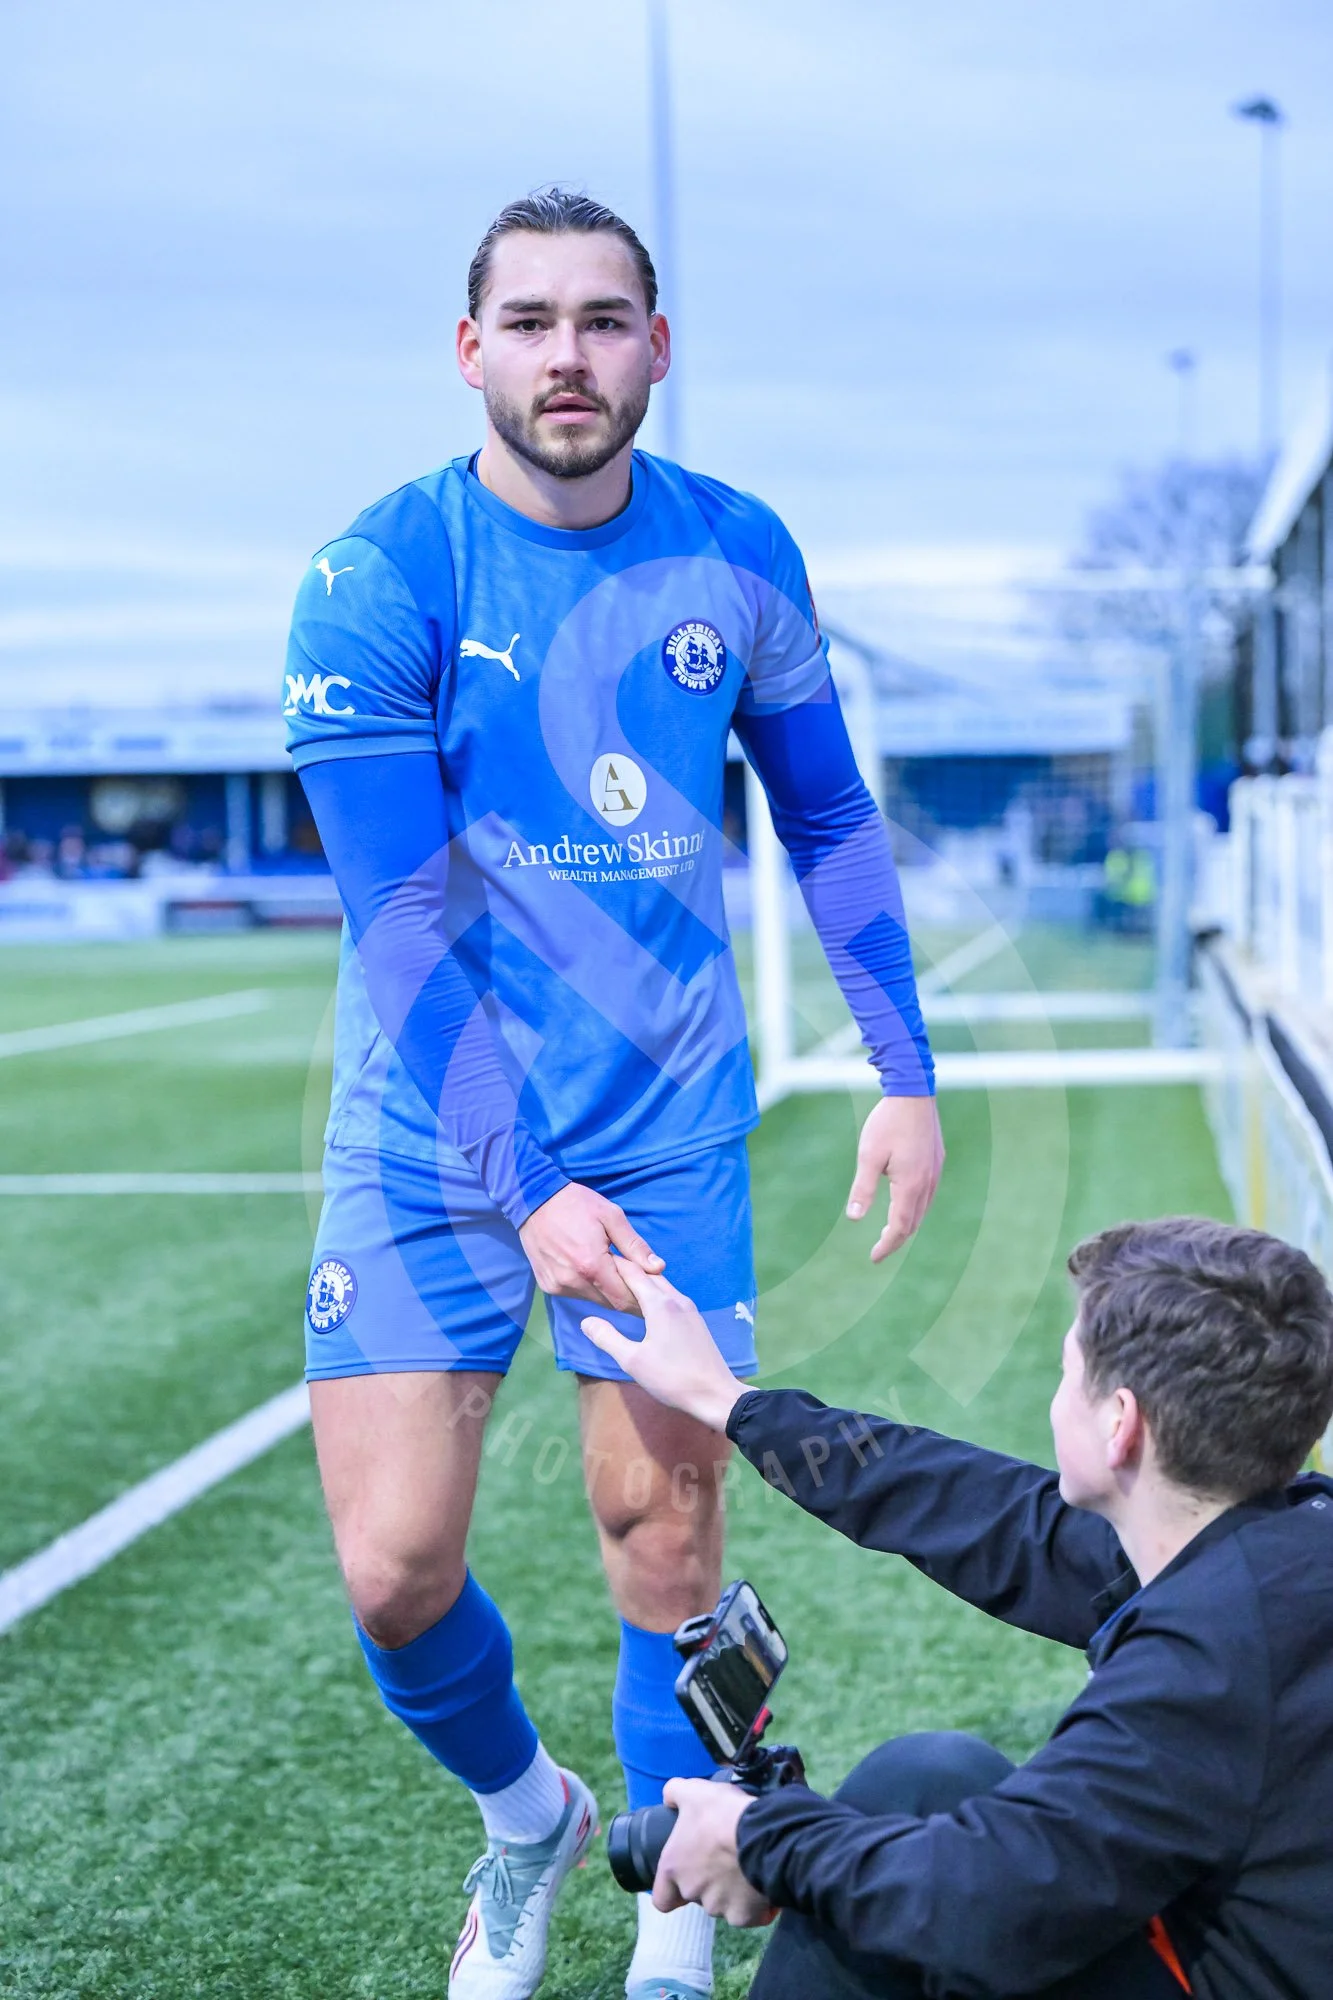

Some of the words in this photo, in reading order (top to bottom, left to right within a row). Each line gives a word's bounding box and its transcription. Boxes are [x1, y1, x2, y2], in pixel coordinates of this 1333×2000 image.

[665, 623, 724, 656] BILLERICAY
[671, 665, 707, 690] TOWN
[502, 834, 623, 869] Andrew
[627, 829, 705, 863] Skinn
[548, 869, 598, 883] WEALTH
[600, 864, 679, 883] MANAGEMENT
[680, 859, 695, 873] LTD
